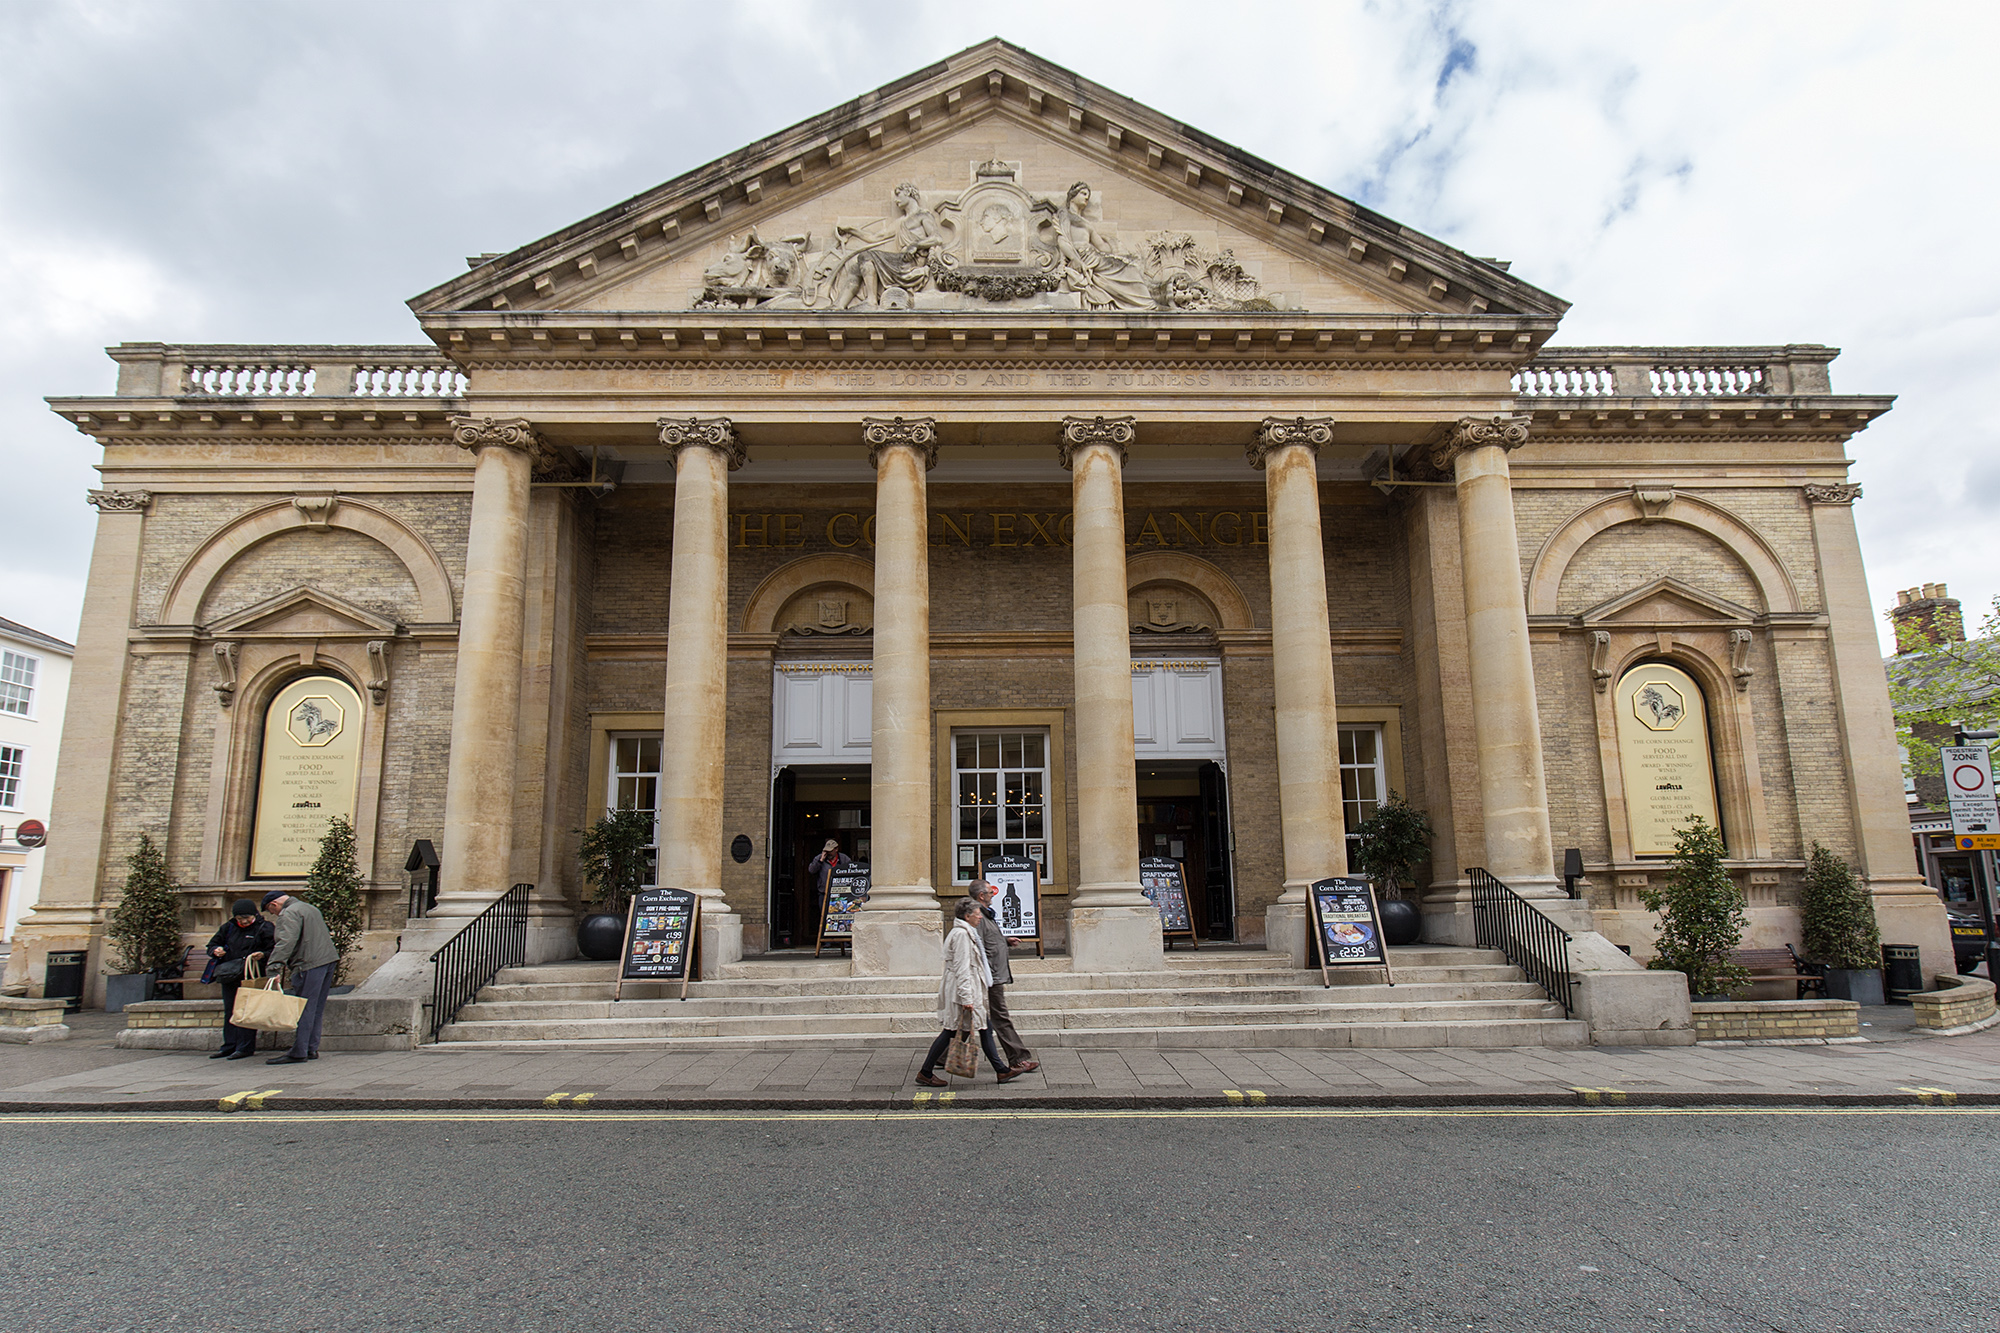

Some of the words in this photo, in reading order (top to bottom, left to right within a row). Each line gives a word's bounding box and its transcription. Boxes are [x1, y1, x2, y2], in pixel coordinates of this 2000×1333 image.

[649, 373, 693, 387] THE
[706, 373, 781, 387] EARTH
[793, 373, 815, 387] IS
[831, 373, 876, 387] THE
[890, 373, 968, 387] LORD'S
[981, 373, 1032, 387] AND
[1046, 373, 1092, 387] THE
[1106, 373, 1211, 387] FULNESS
[728, 513, 806, 548] HE
[826, 512, 974, 548] CN
[1163, 660, 1209, 670] HOUSE
[1952, 753, 1979, 761] ZONE
[1339, 946, 1366, 958] £2.99
